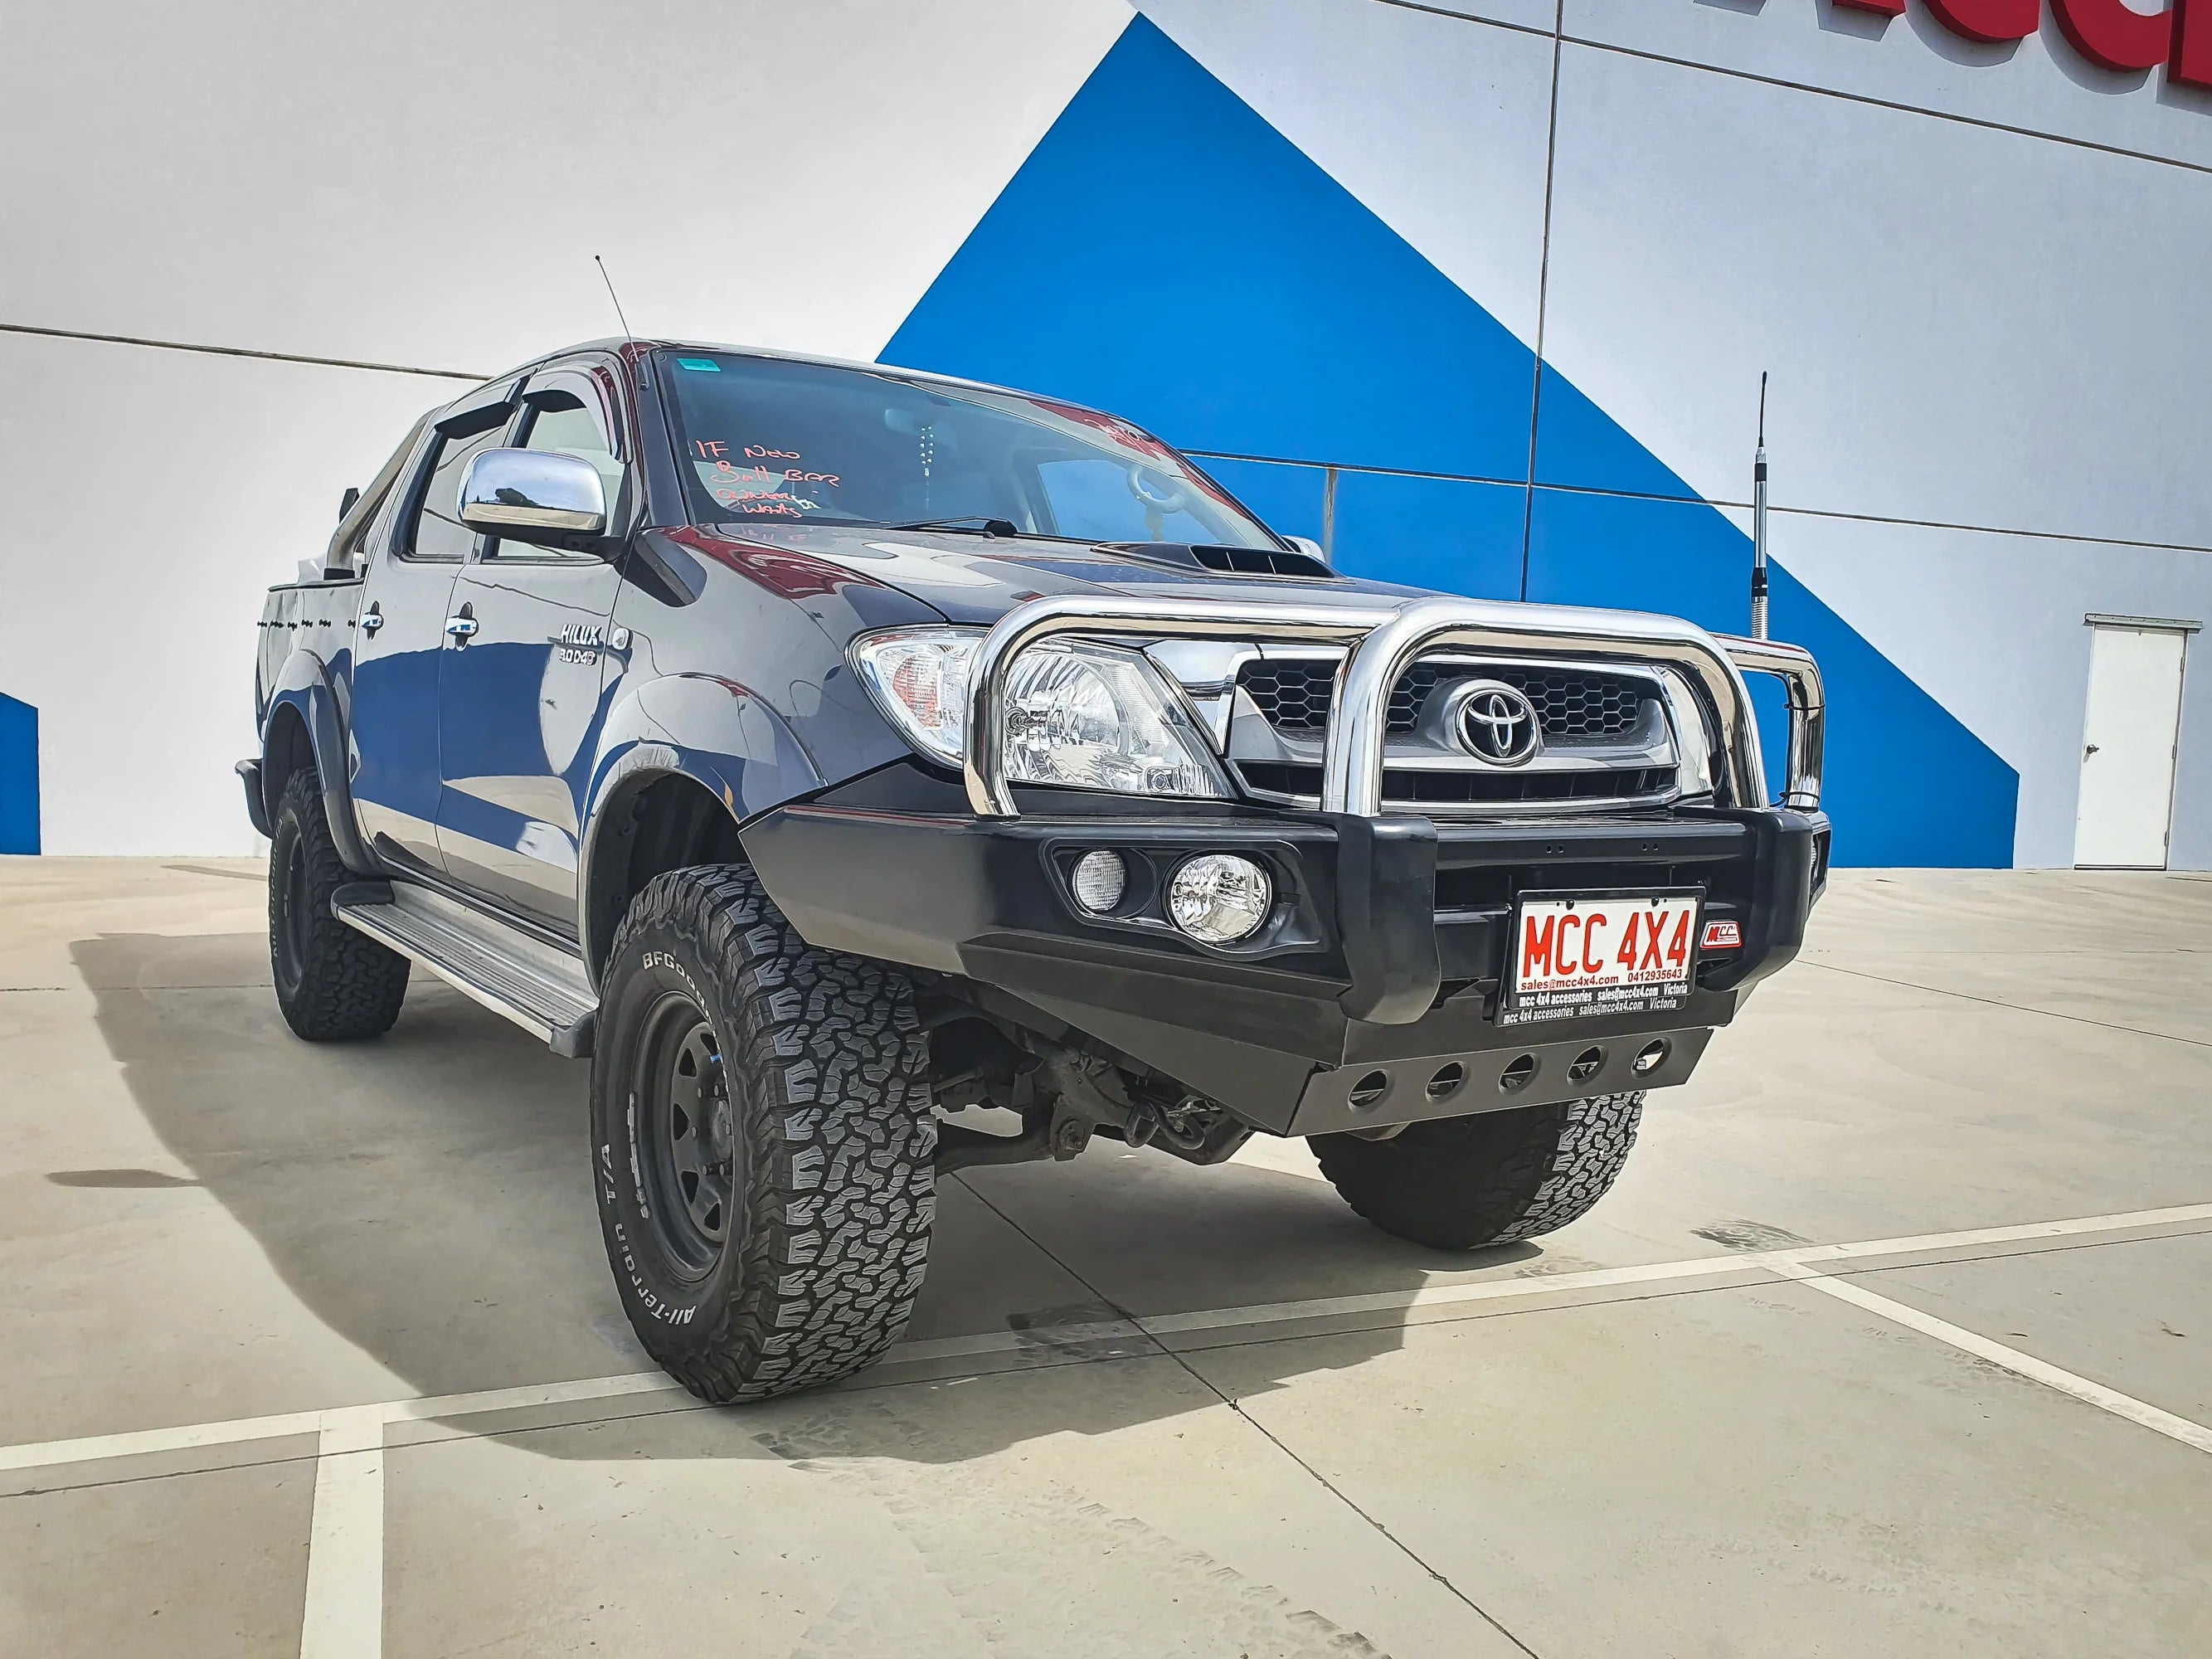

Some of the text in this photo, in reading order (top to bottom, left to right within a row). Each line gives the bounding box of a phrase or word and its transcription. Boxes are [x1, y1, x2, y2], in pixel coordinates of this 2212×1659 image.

[561, 624, 601, 645] HILUX
[1523, 910, 1689, 977] MCC 4X4
[1521, 968, 1683, 991] sales@mcc4x4.com 0412935643
[1519, 982, 1688, 1008] mcc 4x4 accessories sales@mcc4x4.com Victoria
[1503, 997, 1677, 1024] mcc 4x4 accessories sales@mcc4x4.com Victoria
